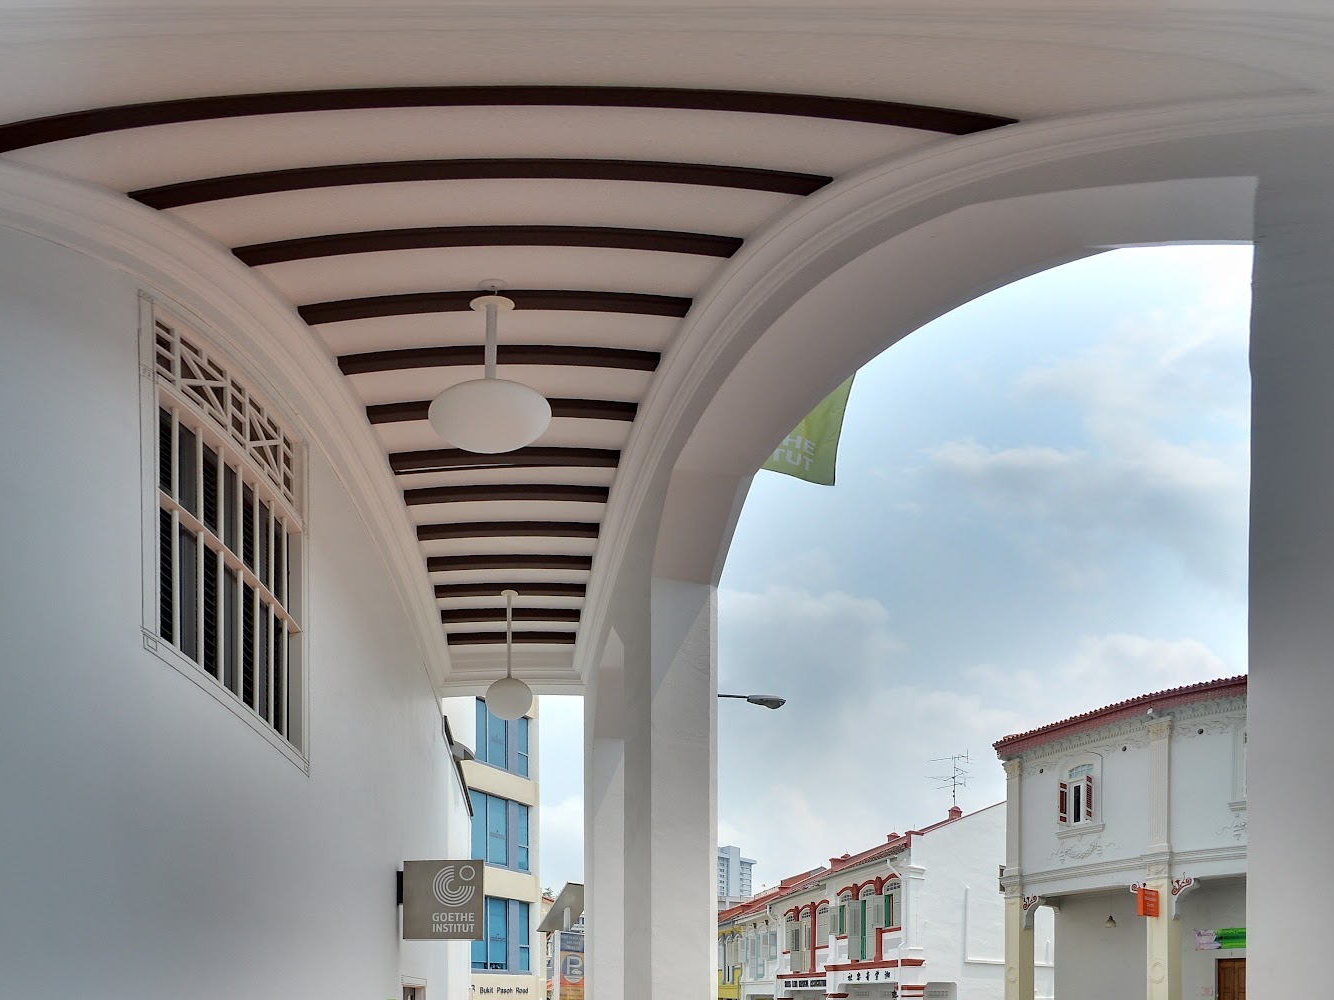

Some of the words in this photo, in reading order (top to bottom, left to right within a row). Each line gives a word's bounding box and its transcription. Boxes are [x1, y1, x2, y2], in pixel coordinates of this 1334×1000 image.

[432, 912, 475, 922] GOETHE
[432, 923, 475, 933] INSTITUT
[479, 986, 494, 994] Bukit
[496, 986, 513, 994] Pasoh
[515, 986, 529, 994] Road
